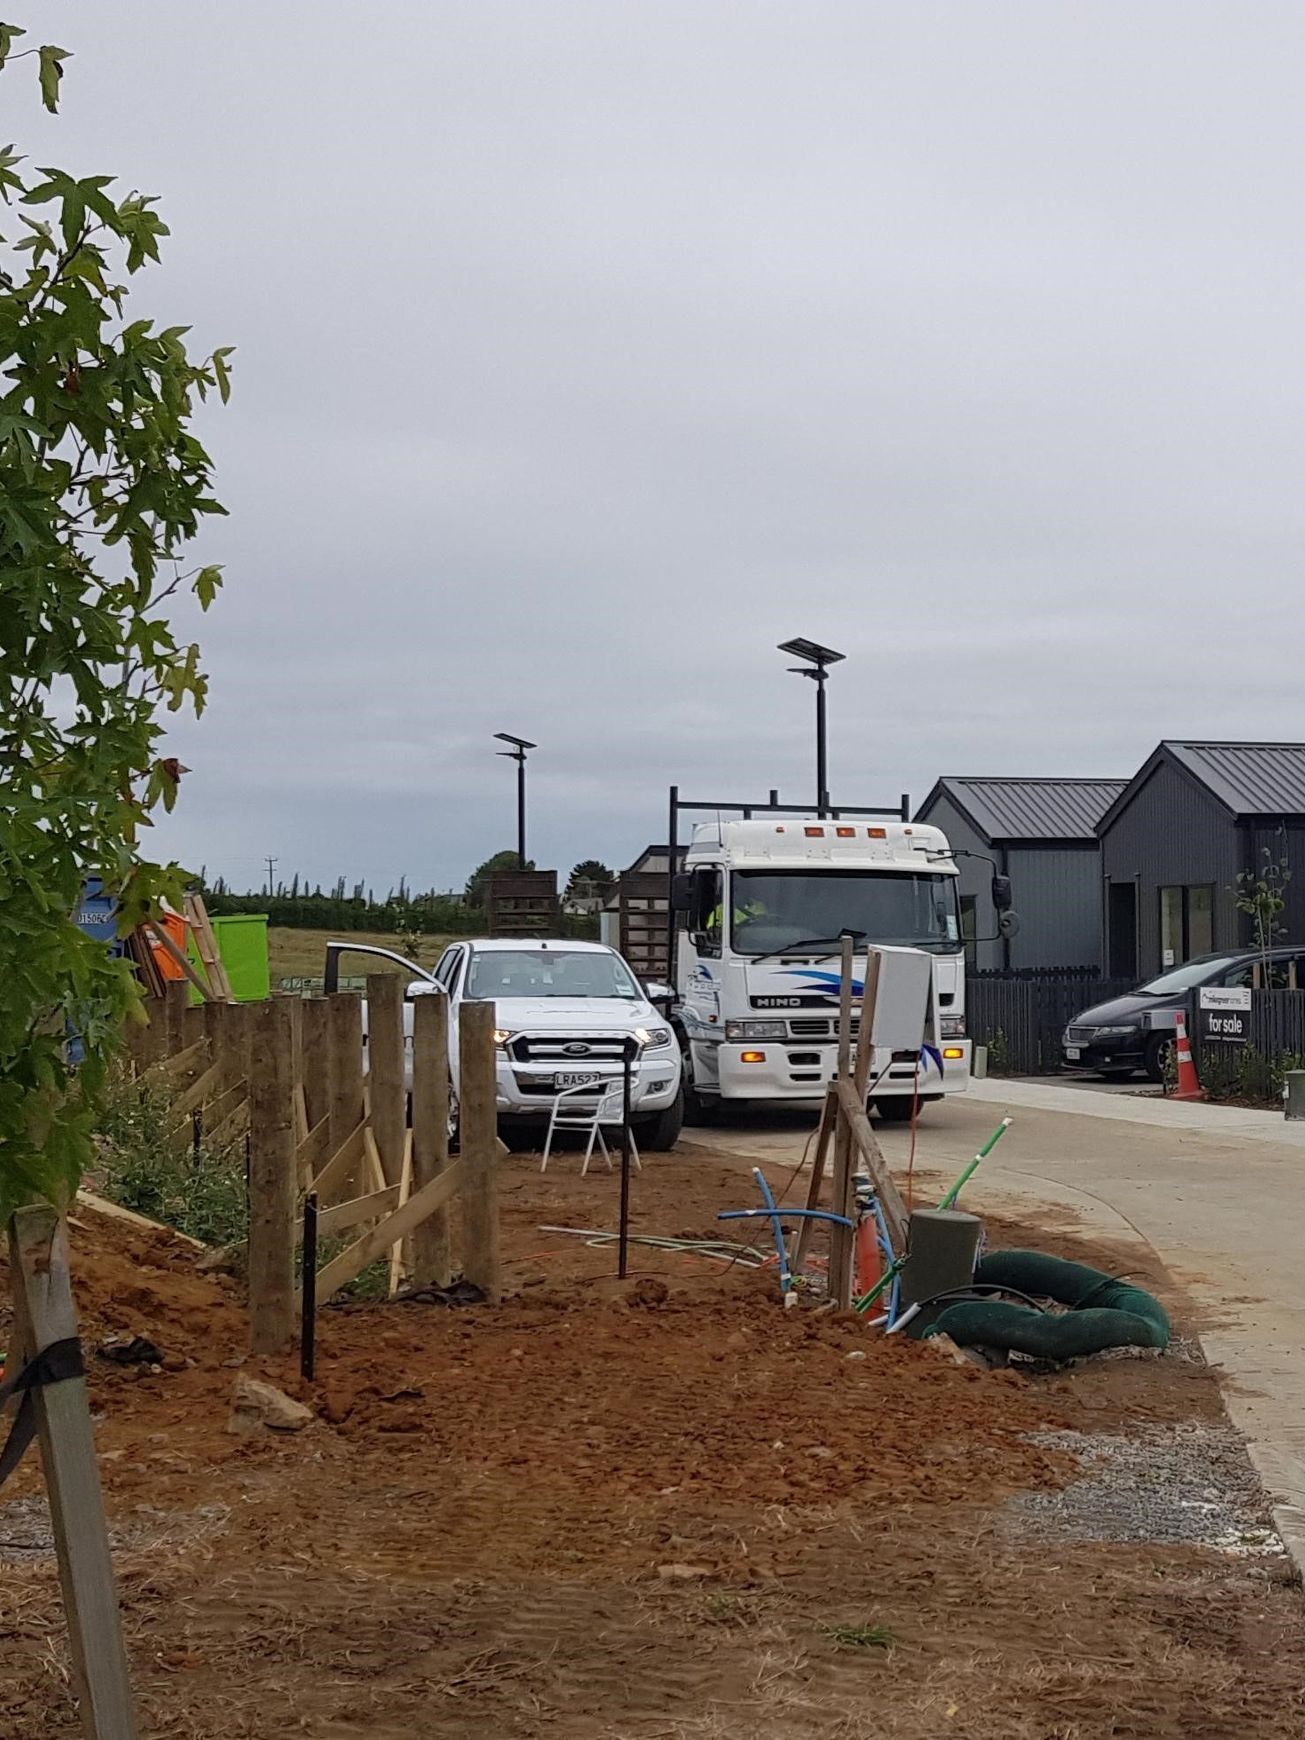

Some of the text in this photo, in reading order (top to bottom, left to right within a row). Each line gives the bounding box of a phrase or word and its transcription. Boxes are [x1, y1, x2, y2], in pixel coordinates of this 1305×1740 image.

[757, 998, 801, 1007] HINO
[1209, 1012, 1243, 1034] for sale
